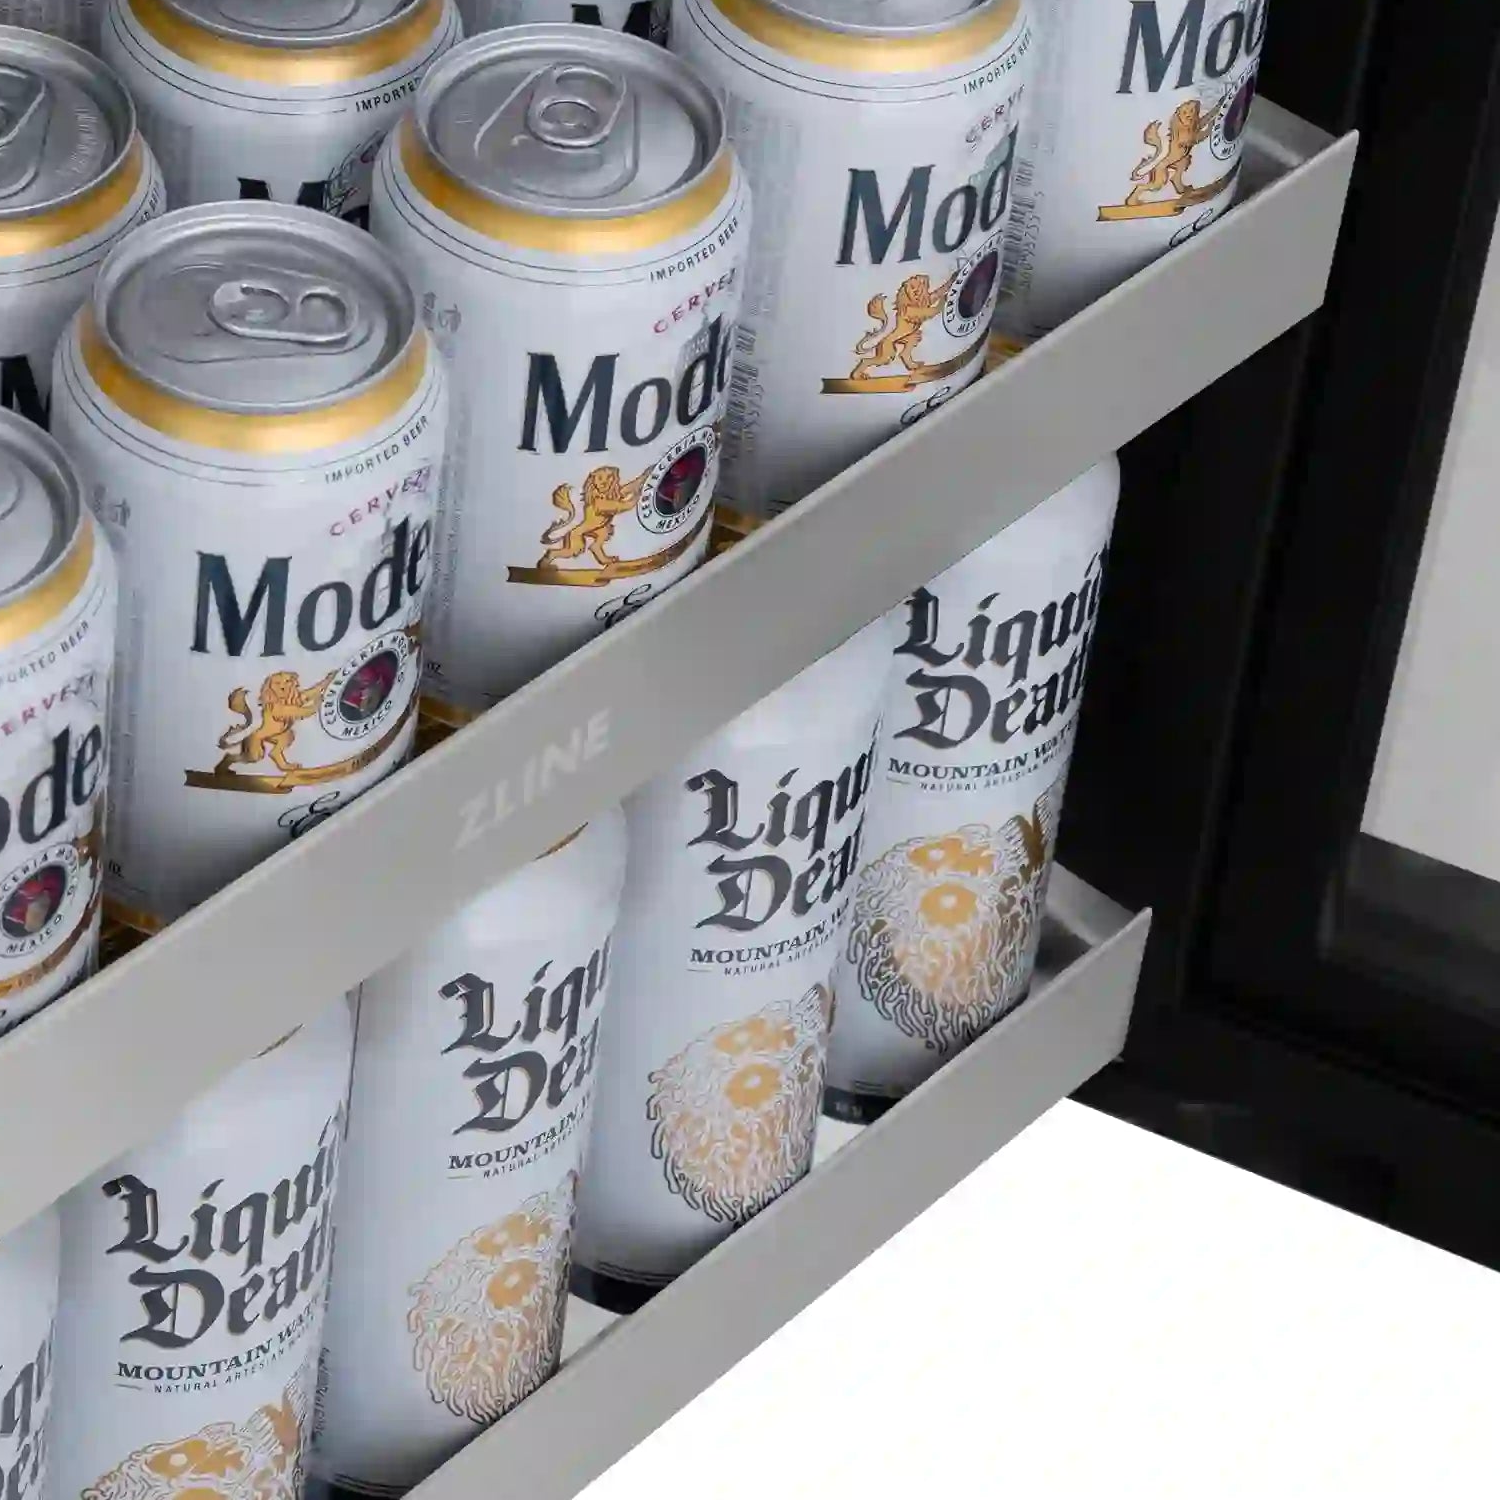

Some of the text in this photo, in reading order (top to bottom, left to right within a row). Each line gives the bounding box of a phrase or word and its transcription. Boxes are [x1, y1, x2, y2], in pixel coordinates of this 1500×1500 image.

[963, 54, 1017, 94] IMPORTED
[834, 122, 1018, 266] Mod
[650, 243, 716, 283] IMPORTED
[190, 515, 432, 657] Mode
[454, 709, 610, 853] ZLINE
[888, 753, 1028, 779] MOUNTAIN
[690, 920, 826, 964] MOUNTAIN
[448, 1107, 581, 1170] MOUNTAIN
[116, 1338, 272, 1381] MOUNTAIN
[154, 1381, 218, 1394] NATURAL
